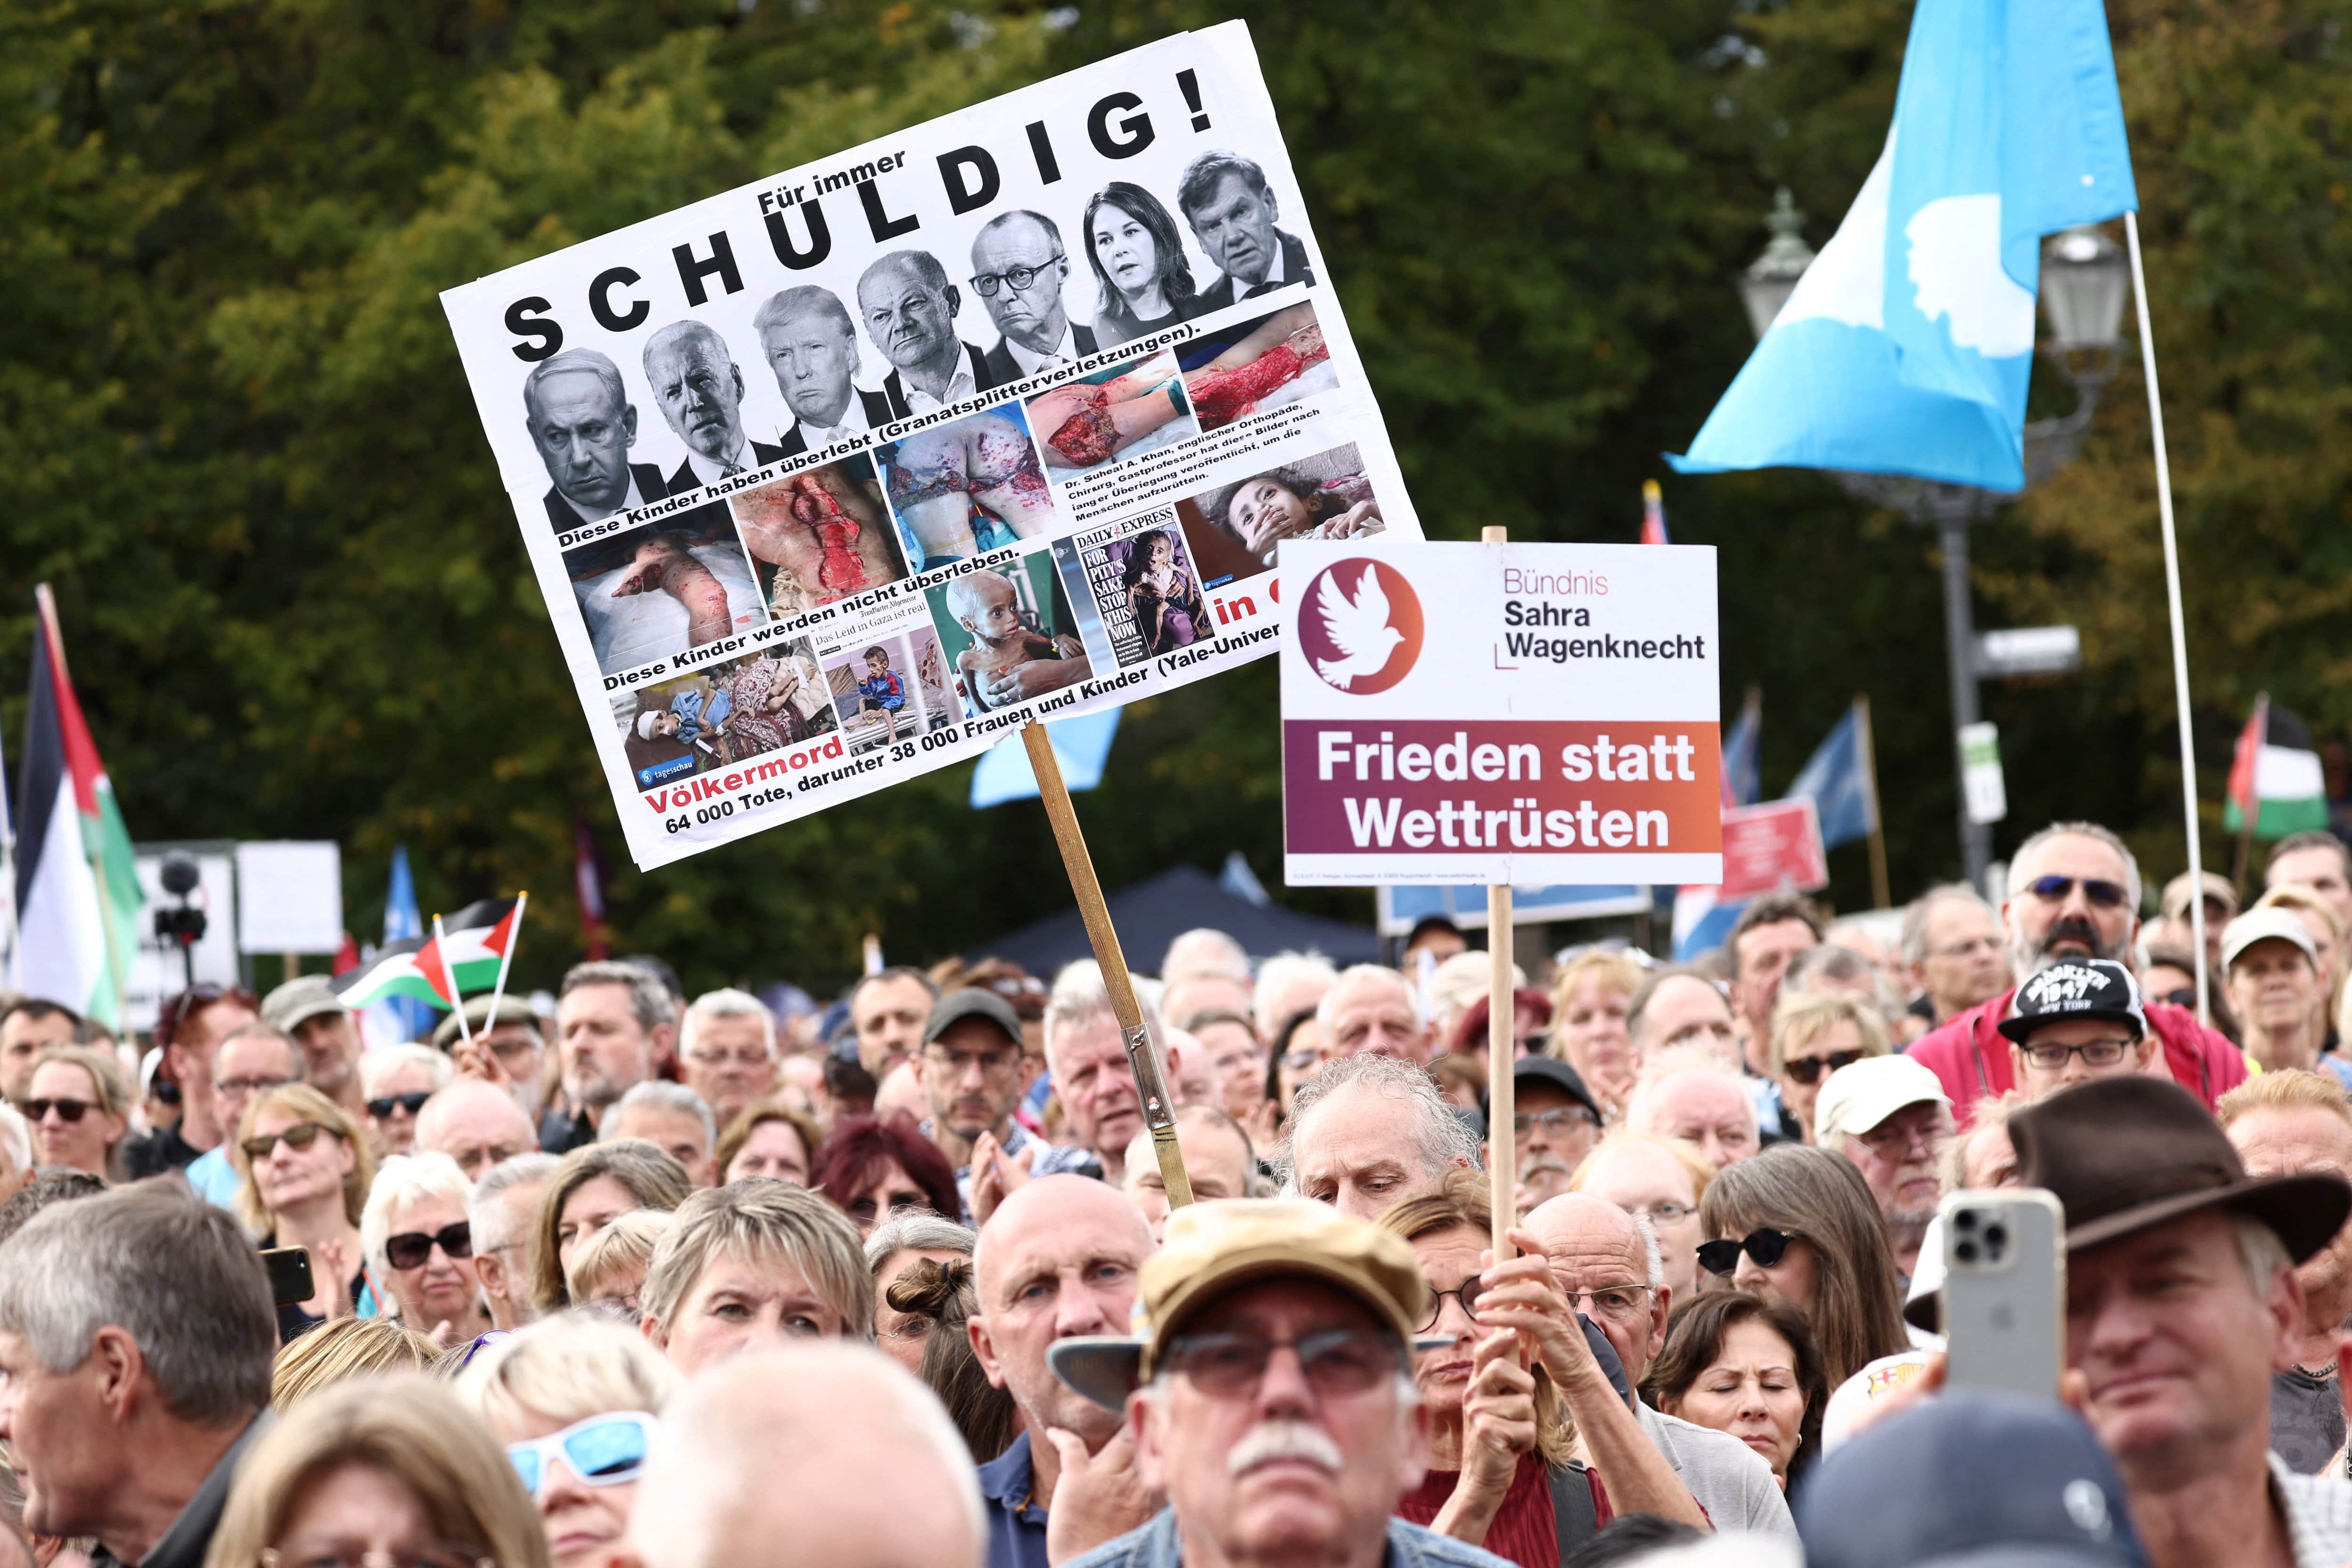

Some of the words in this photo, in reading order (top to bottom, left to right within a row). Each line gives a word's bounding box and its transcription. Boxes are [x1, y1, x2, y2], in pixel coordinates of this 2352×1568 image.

[757, 186, 805, 215] Für
[812, 150, 905, 196] immer
[558, 521, 620, 547] Diese
[626, 493, 699, 525] Kinder
[705, 469, 774, 498] haben
[780, 433, 873, 473] überlebt
[879, 324, 1201, 443] (Granatsplitterverletzungen).
[1065, 481, 1081, 490] Dr.
[1084, 464, 1123, 483] Suheal
[1141, 449, 1175, 463] Khan,
[1177, 426, 1236, 450] englischer
[1239, 405, 1303, 429] Orthopäde,
[1118, 451, 1197, 482] Gastprofessor
[1200, 443, 1219, 454] hat
[1255, 420, 1289, 435] Bilder
[1292, 409, 1320, 423] nach
[1263, 437, 1281, 446] um
[1283, 429, 1301, 439] die
[1076, 498, 1134, 522] Menschen
[1137, 474, 1209, 501] aufzurütteln.
[1076, 527, 1115, 548] DAILY
[1120, 506, 1174, 533] EXPRESS
[1059, 547, 1071, 555] ZDF
[1084, 547, 1109, 567] FOR
[1089, 558, 1127, 582] PITY'S
[1211, 576, 1233, 588] tagesschau
[1504, 568, 1608, 595] Bündnis
[1094, 576, 1125, 597] SAKE
[859, 604, 889, 618] Frankfurter
[890, 596, 916, 609] Allgemeine
[1099, 590, 1129, 612] STOP
[1505, 601, 1590, 627] Sahra
[603, 664, 666, 691] Diese
[672, 637, 746, 669] Kinder
[752, 608, 836, 642] werden
[842, 585, 898, 614] nicht
[904, 549, 1020, 593] überleben.
[816, 635, 833, 645] Das
[835, 625, 857, 639] Leid
[858, 623, 868, 631] in
[869, 615, 893, 627] Gaza
[894, 609, 906, 620] ist
[907, 602, 926, 615] real
[1104, 605, 1132, 627] THIS
[1109, 620, 1138, 641] NOW
[1506, 633, 1705, 664] Wagenknecht
[645, 735, 844, 814] Völkermord
[1214, 596, 1257, 625] in
[666, 814, 691, 834] 64
[696, 801, 734, 824] 000
[738, 788, 792, 810] Tote,
[798, 755, 884, 792] darunter
[890, 742, 916, 762] 38
[921, 728, 959, 751] 000
[964, 707, 1033, 738] Frauen
[1038, 689, 1076, 714] und
[1080, 668, 1148, 700] Kinder
[1319, 731, 1541, 781] Frieden
[1562, 735, 1695, 782] statt
[653, 760, 694, 780] tagesschau
[1344, 798, 1669, 848] Wettrüsten
[2025, 964, 2111, 1003] BROOKLYN
[2042, 980, 2089, 1005] 1947
[2063, 999, 2092, 1011] YORK
